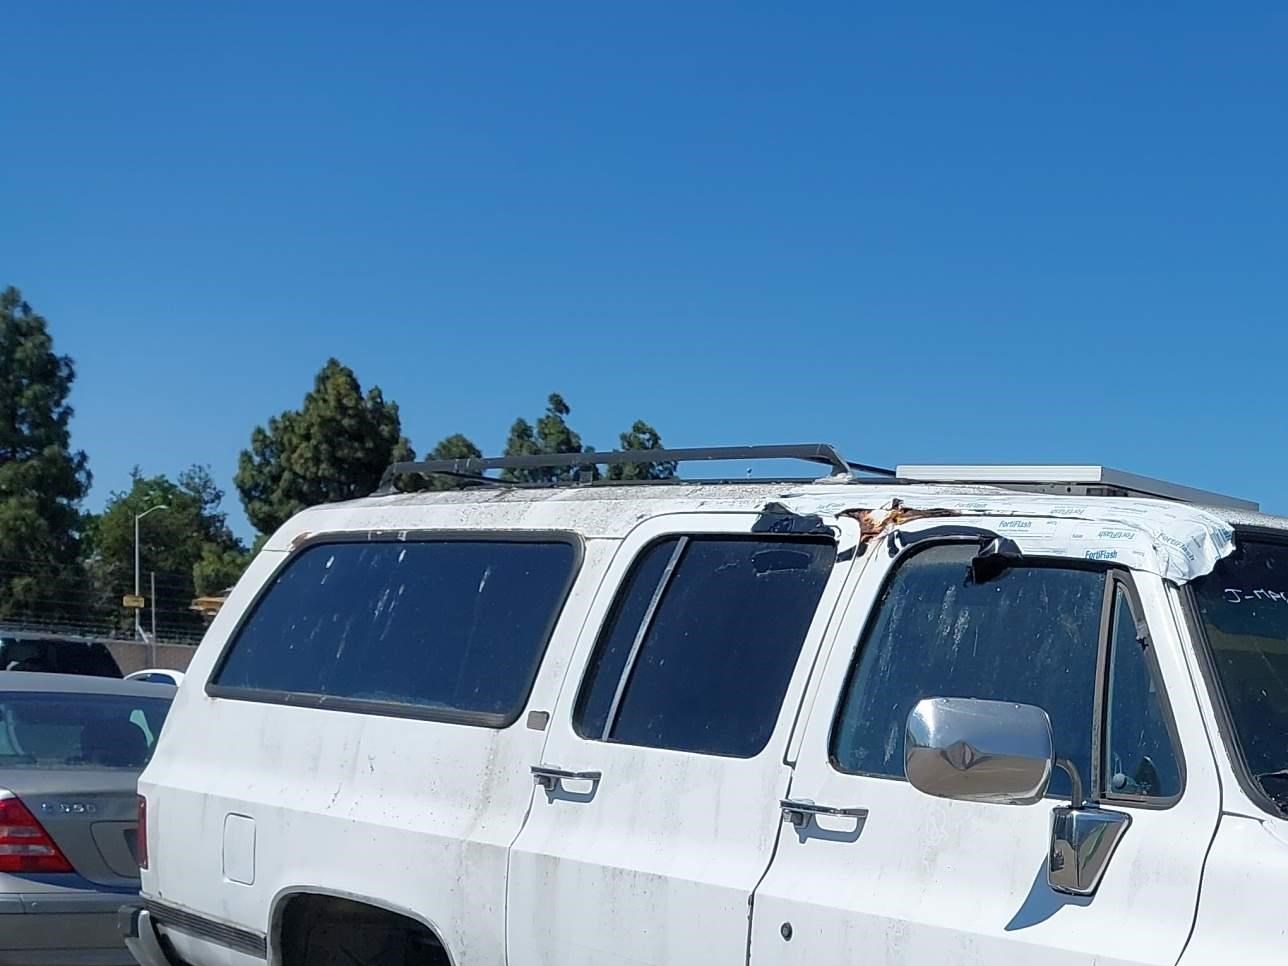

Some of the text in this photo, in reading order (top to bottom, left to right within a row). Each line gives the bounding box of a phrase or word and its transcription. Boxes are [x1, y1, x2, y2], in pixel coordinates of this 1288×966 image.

[998, 519, 1033, 529] FortiFlash
[1097, 530, 1137, 541] FortiFlash
[1156, 532, 1196, 562] FortiFlash
[1084, 549, 1119, 560] FortiFlash
